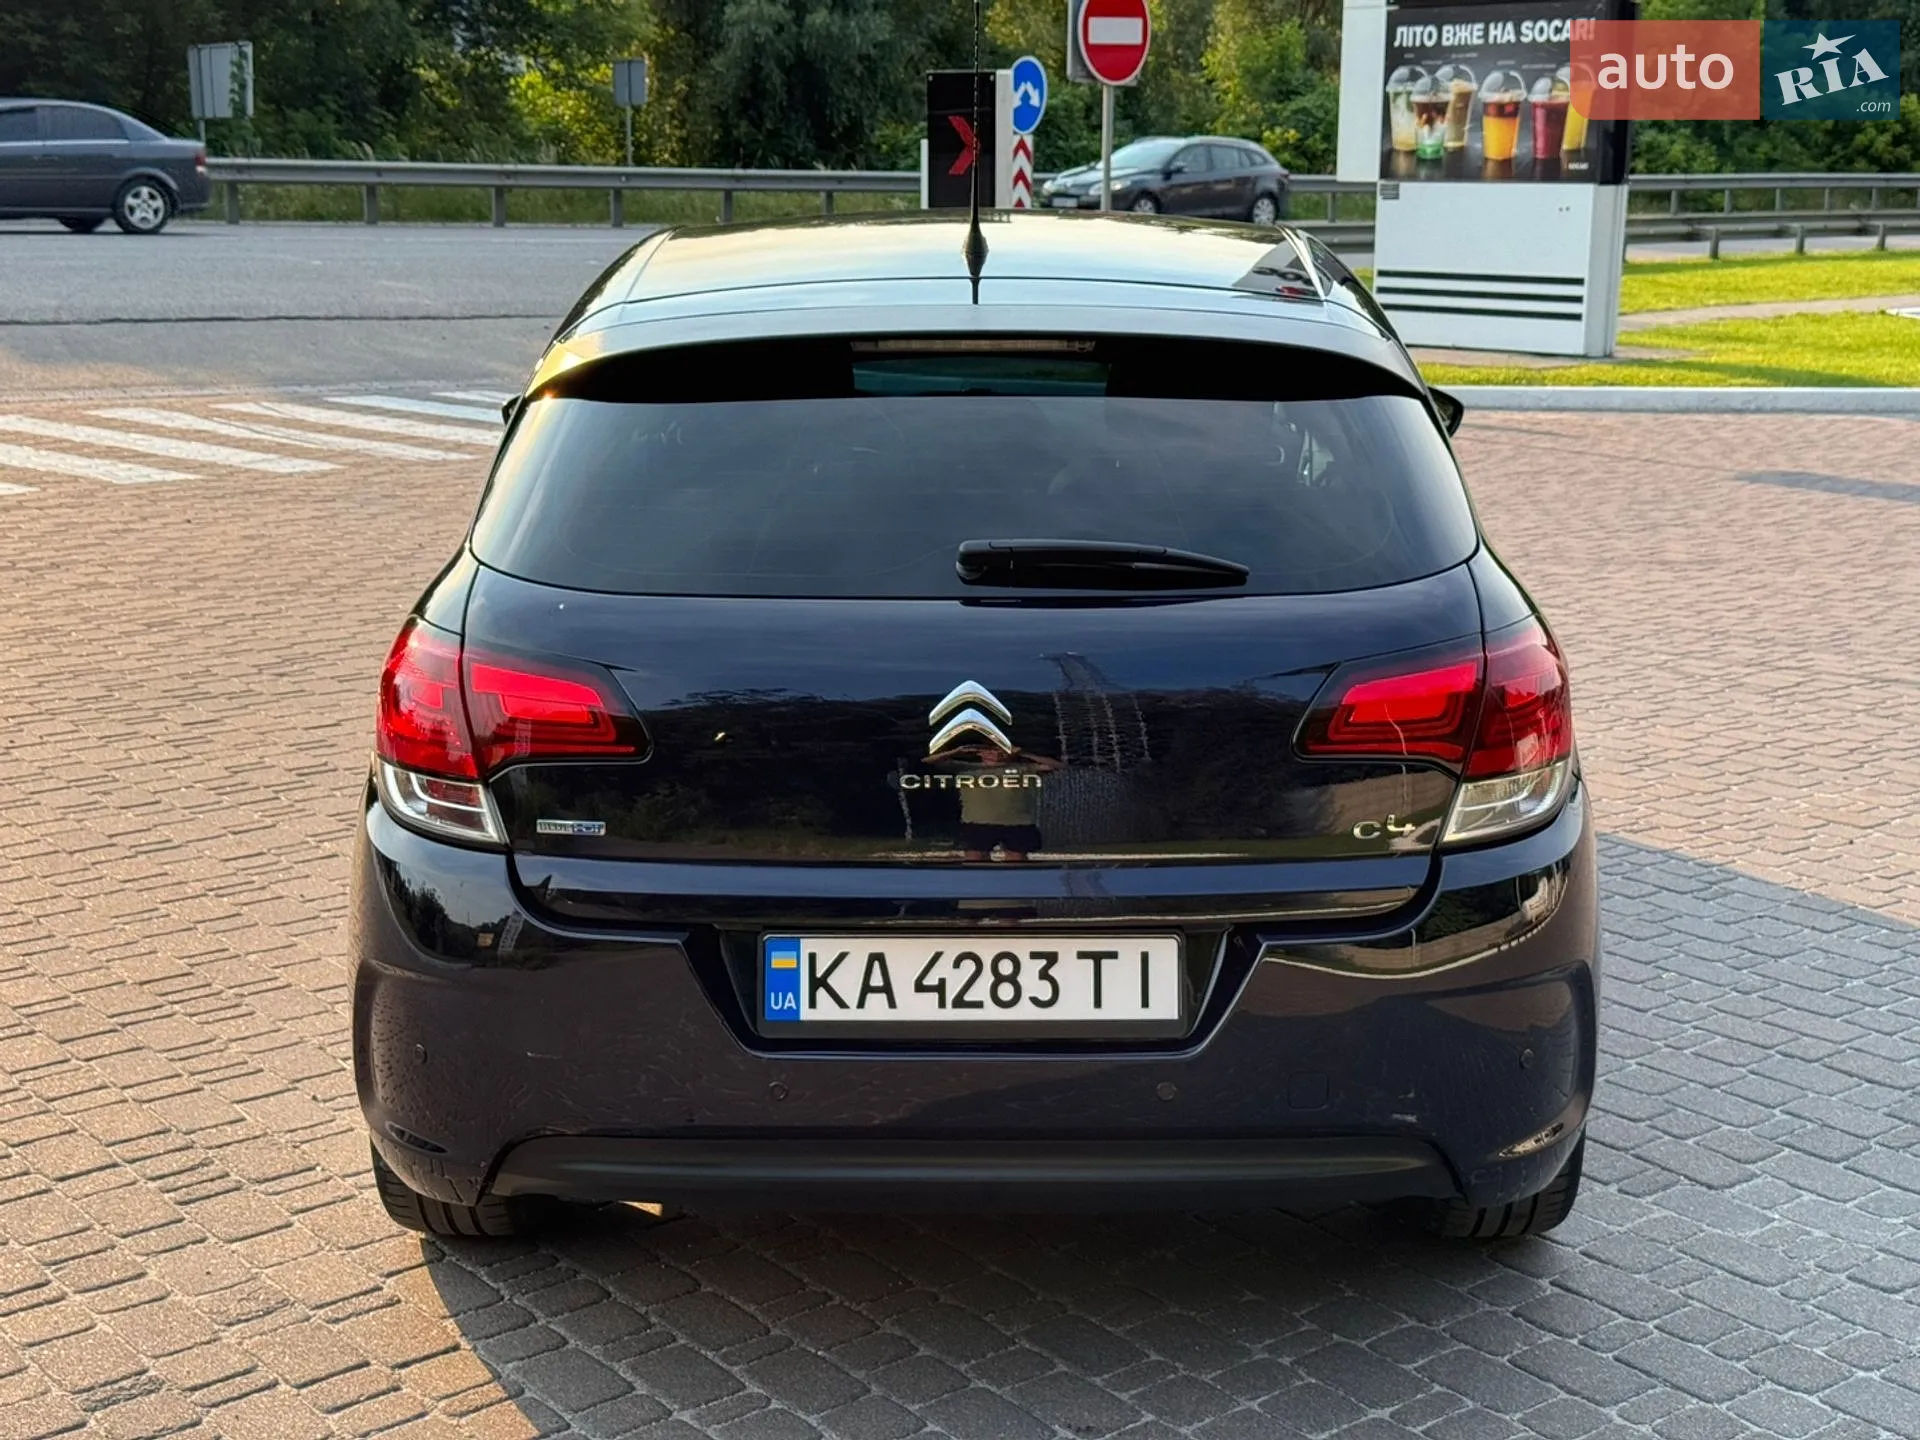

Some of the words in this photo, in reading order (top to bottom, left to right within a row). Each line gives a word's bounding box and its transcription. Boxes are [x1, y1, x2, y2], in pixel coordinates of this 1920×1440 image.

[1393, 24, 1438, 48] ЛІТО
[1441, 22, 1485, 47] ВЖЕ
[1488, 20, 1516, 45] НА
[1520, 17, 1597, 44] SOCAR!
[1353, 814, 1416, 838] C4
[807, 950, 898, 1010] KA
[913, 950, 1060, 1010] 4283
[770, 991, 797, 1011] UA
